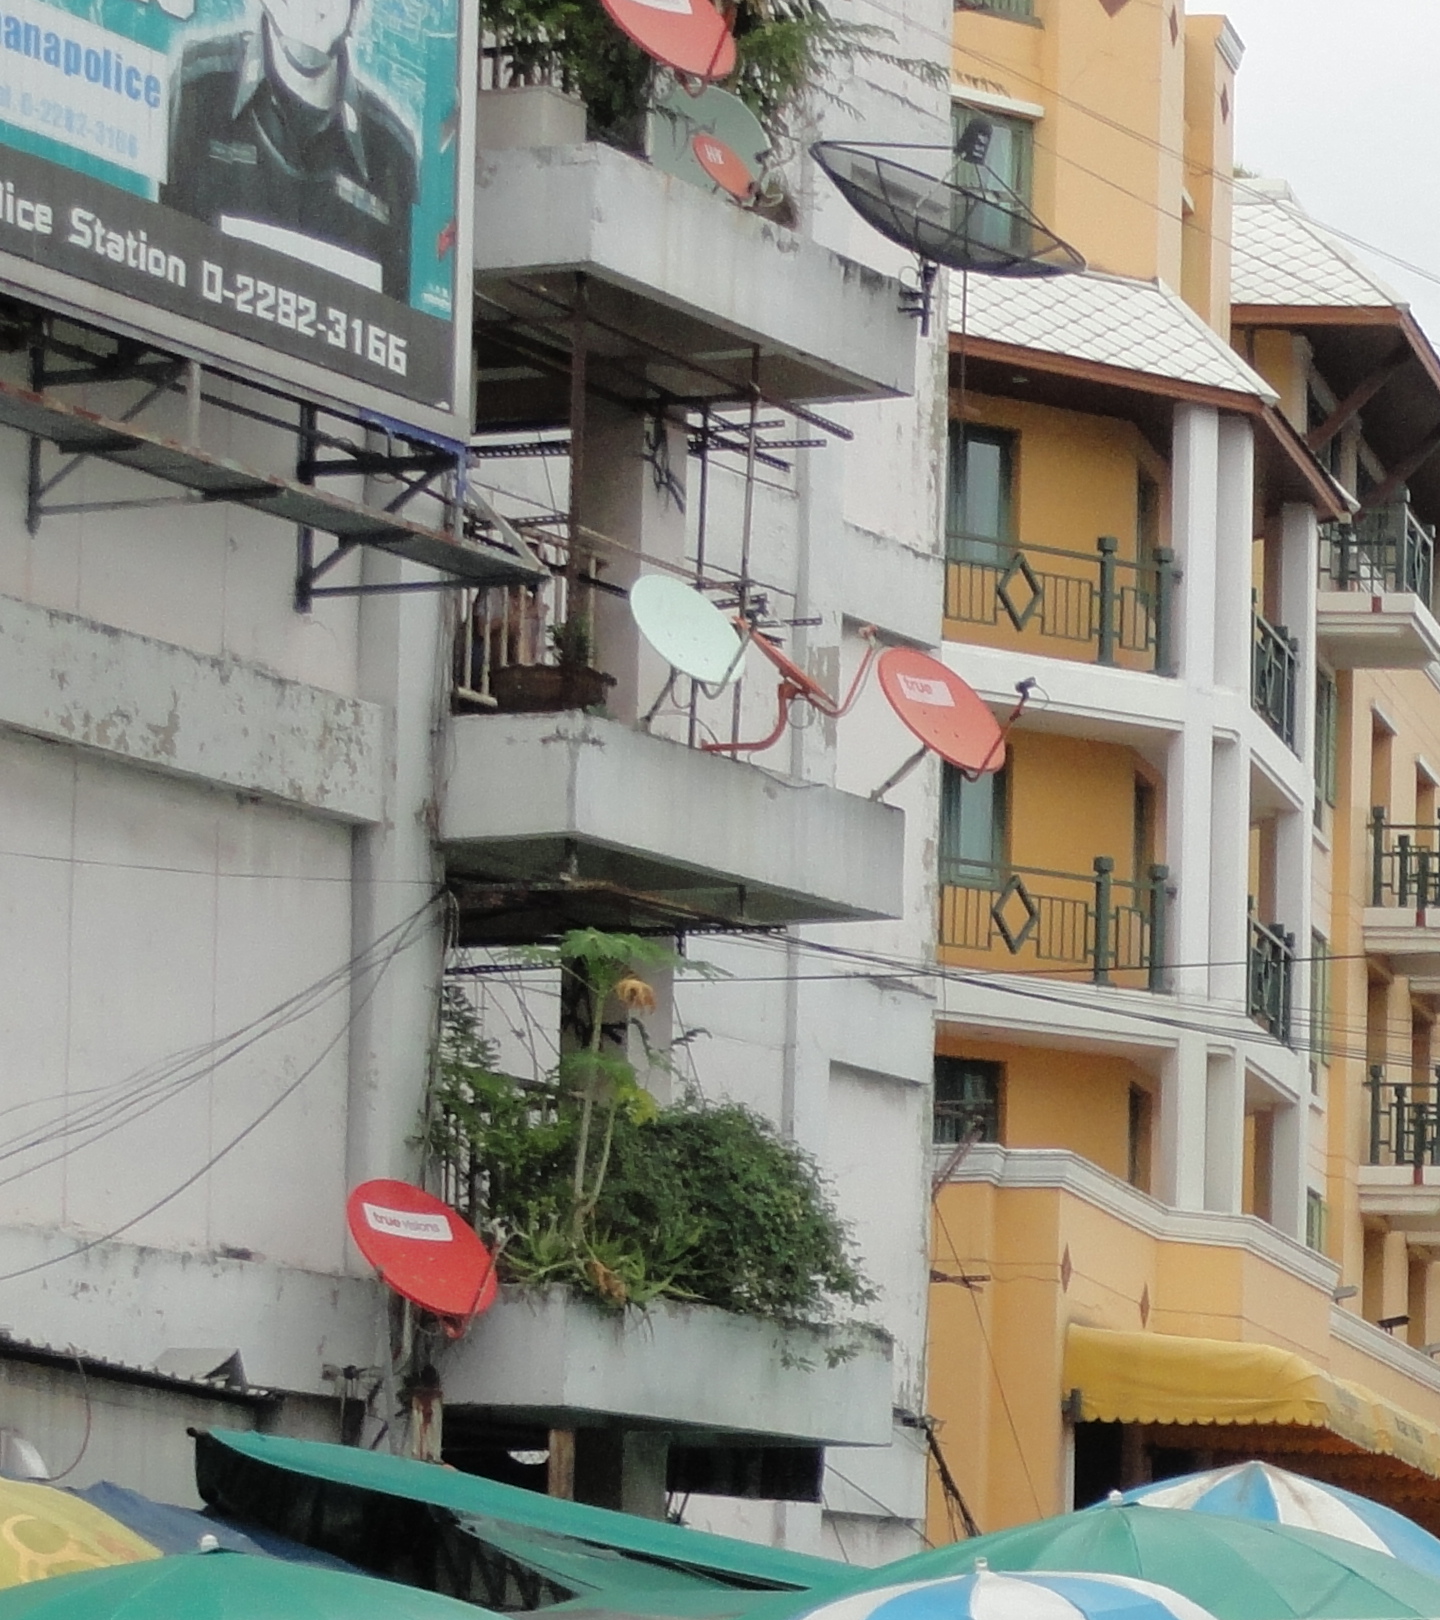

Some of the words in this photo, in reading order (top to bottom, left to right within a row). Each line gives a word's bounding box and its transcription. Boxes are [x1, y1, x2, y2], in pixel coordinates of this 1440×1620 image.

[68, 207, 187, 287] Station
[202, 261, 407, 376] 0-2282-3166
[373, 1211, 401, 1228] true
